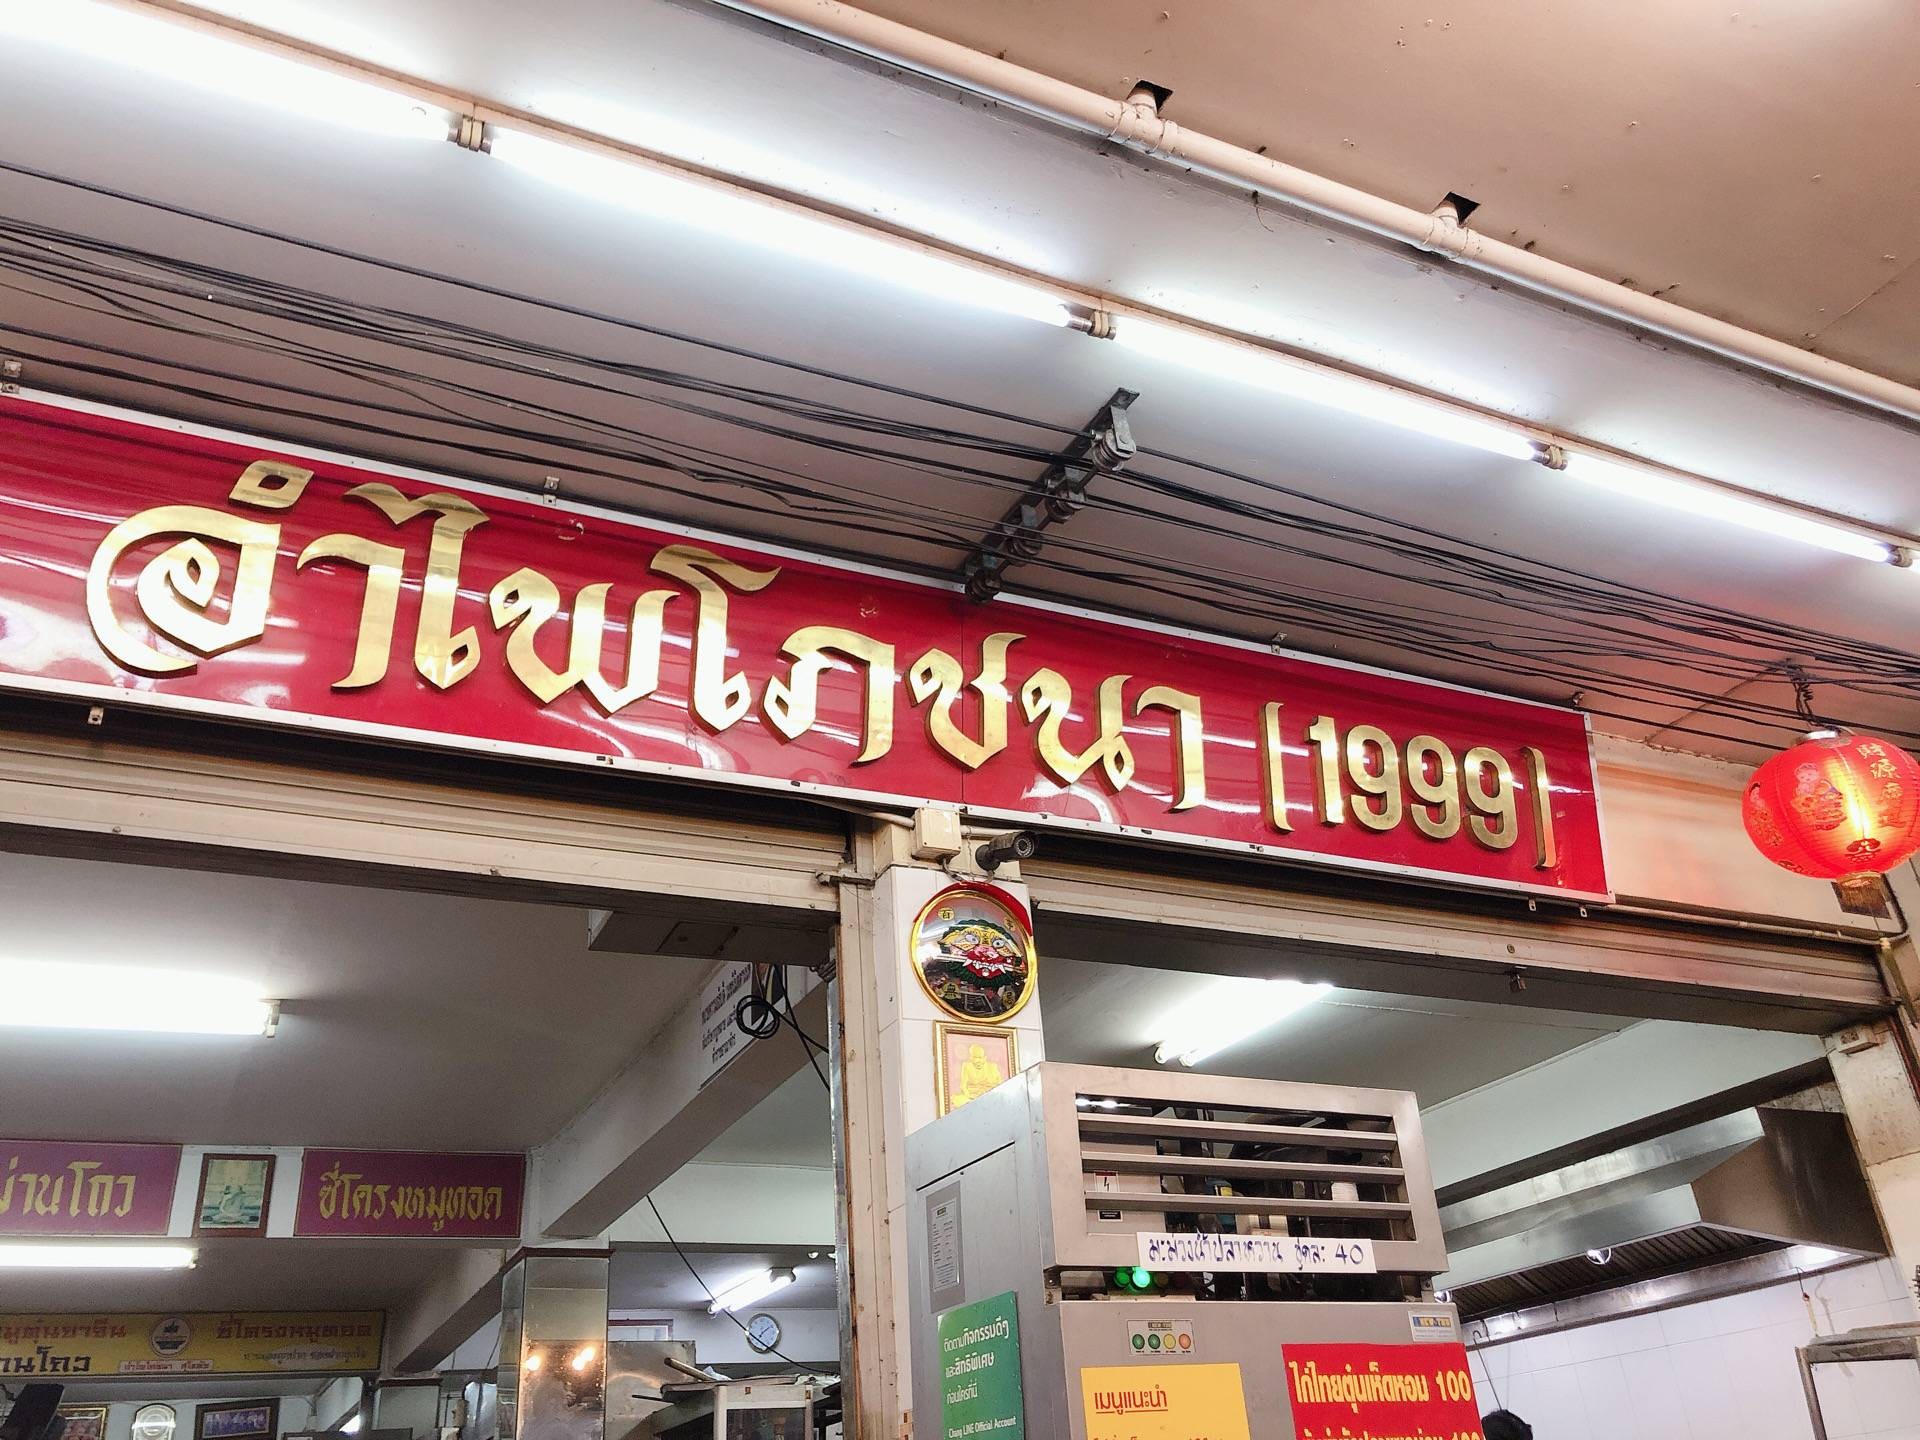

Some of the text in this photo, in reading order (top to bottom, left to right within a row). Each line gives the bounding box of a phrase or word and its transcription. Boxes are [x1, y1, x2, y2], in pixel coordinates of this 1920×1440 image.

[86, 460, 1207, 812] อำไพโภชนา
[319, 1160, 502, 1232] ซี่โครงหมูทอด
[1149, 1228, 1283, 1263] มะม่วงน้ำปลาหวาน
[1334, 1243, 1364, 1265] 40
[0, 1317, 128, 1345] มูตุ๋นยาจีน
[1094, 1384, 1168, 1415] เมนูแนะนำ
[1289, 1360, 1472, 1414] ไก่ไทยตุ๋นเห็ดหอม 100
[963, 1423, 975, 1436] LINE
[975, 1419, 993, 1433] Official
[994, 1415, 1017, 1430] Account
